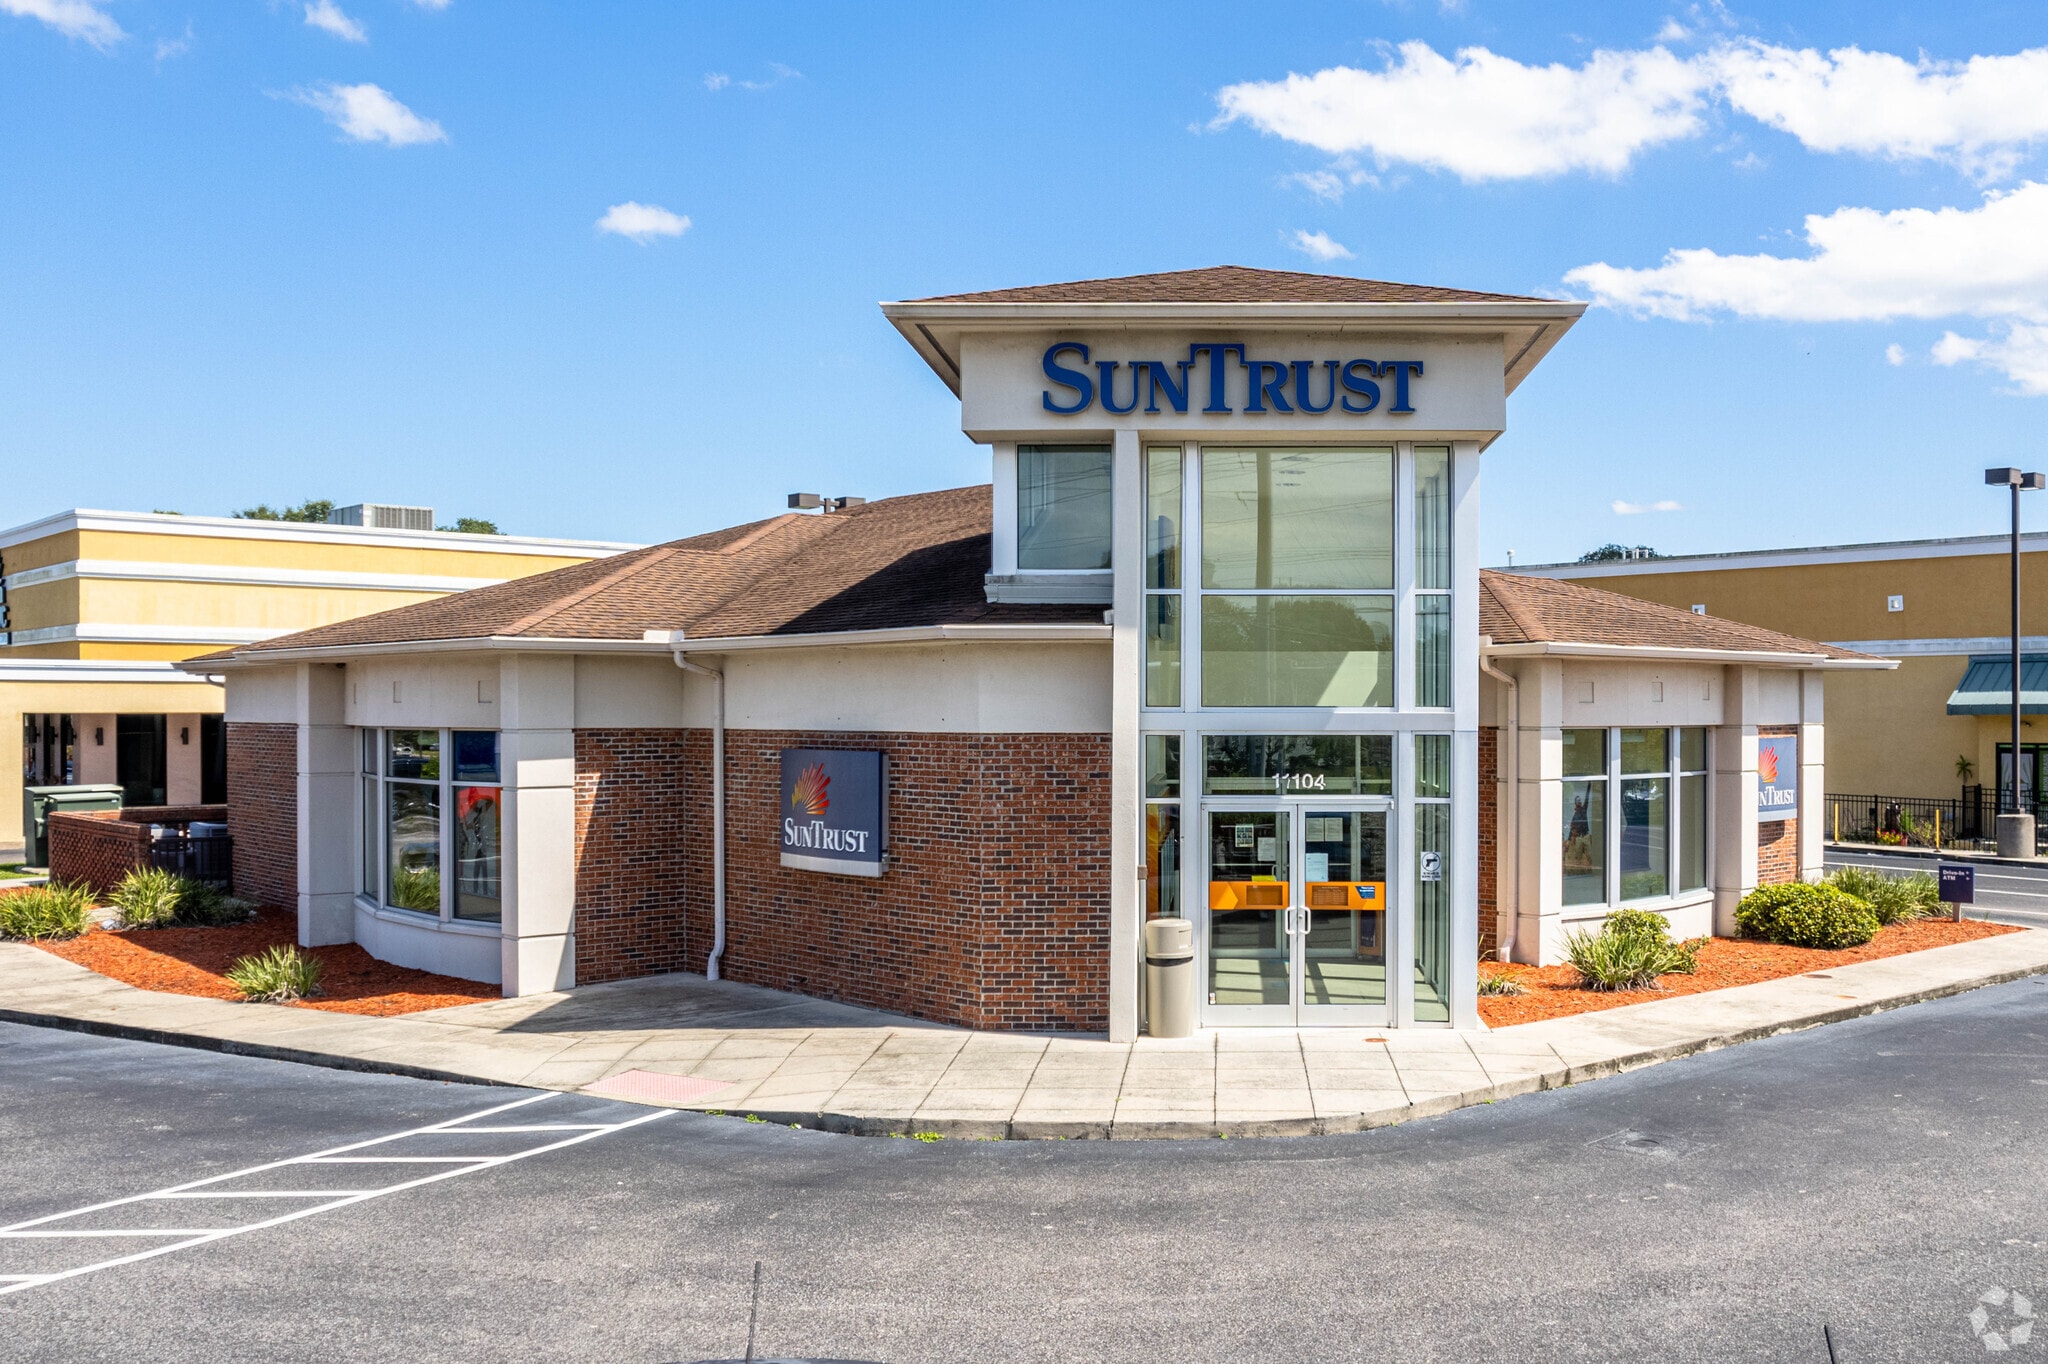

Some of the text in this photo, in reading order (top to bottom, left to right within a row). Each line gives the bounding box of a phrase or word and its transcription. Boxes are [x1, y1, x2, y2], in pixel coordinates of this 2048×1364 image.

[1042, 341, 1424, 415] SUNTRUST
[1272, 773, 1326, 790] 11104
[1758, 785, 1795, 806] NTRUST
[784, 817, 868, 853] SUNTRUST
